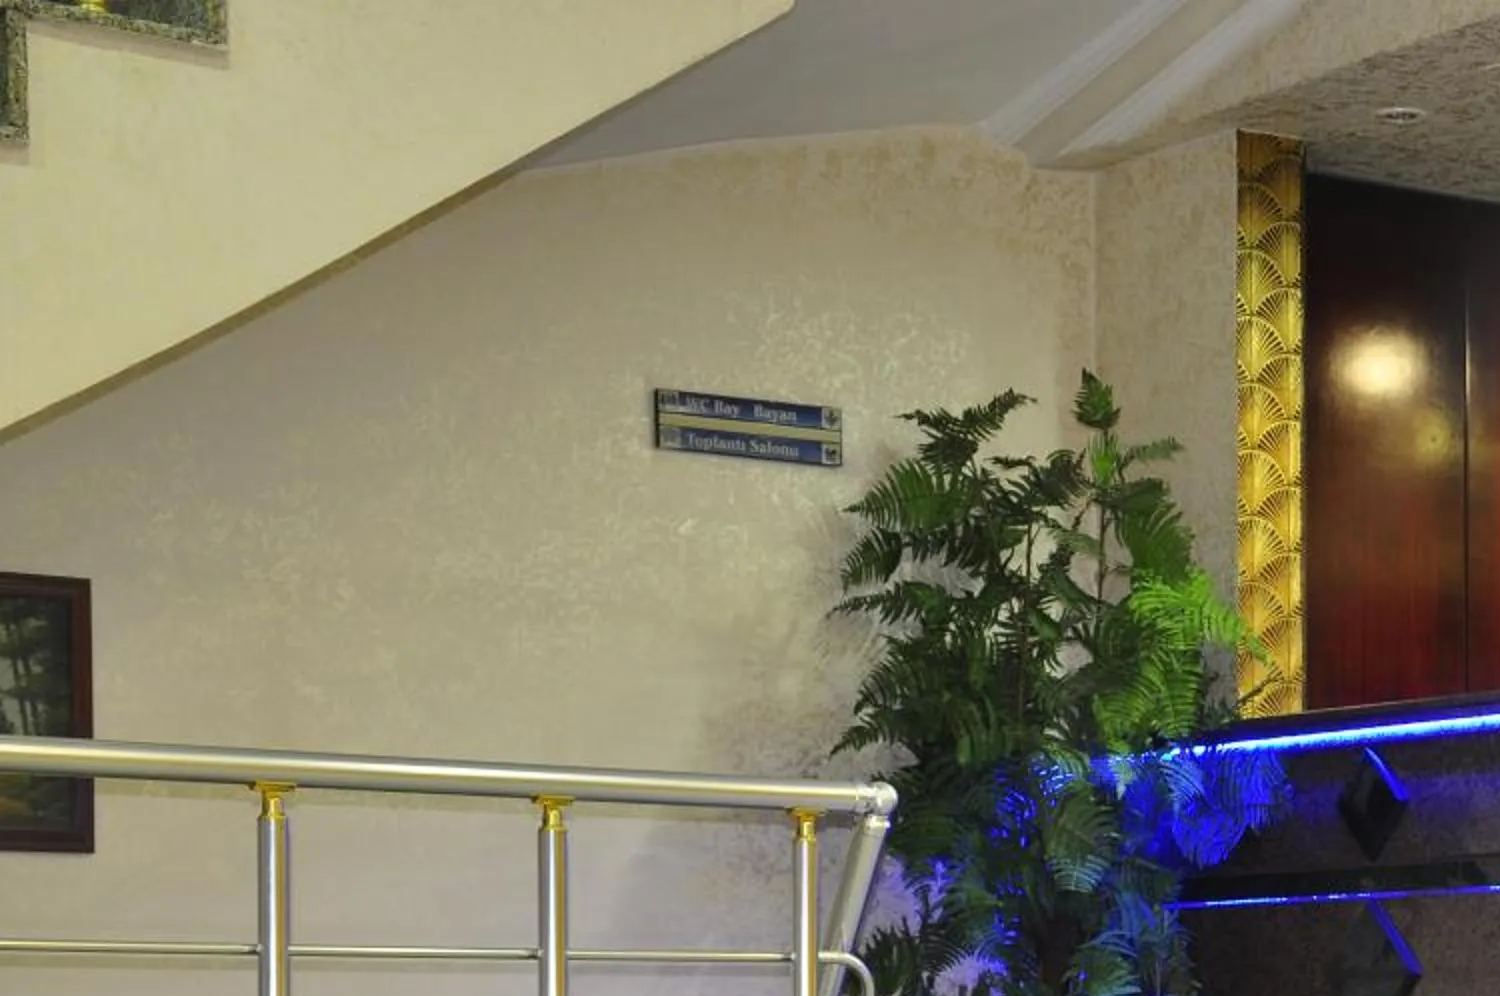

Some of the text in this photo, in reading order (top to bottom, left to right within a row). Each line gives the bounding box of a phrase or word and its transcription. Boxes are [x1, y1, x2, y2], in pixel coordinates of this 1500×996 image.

[685, 396, 797, 423] WC Bay Bayan
[749, 439, 800, 457] Salonu
